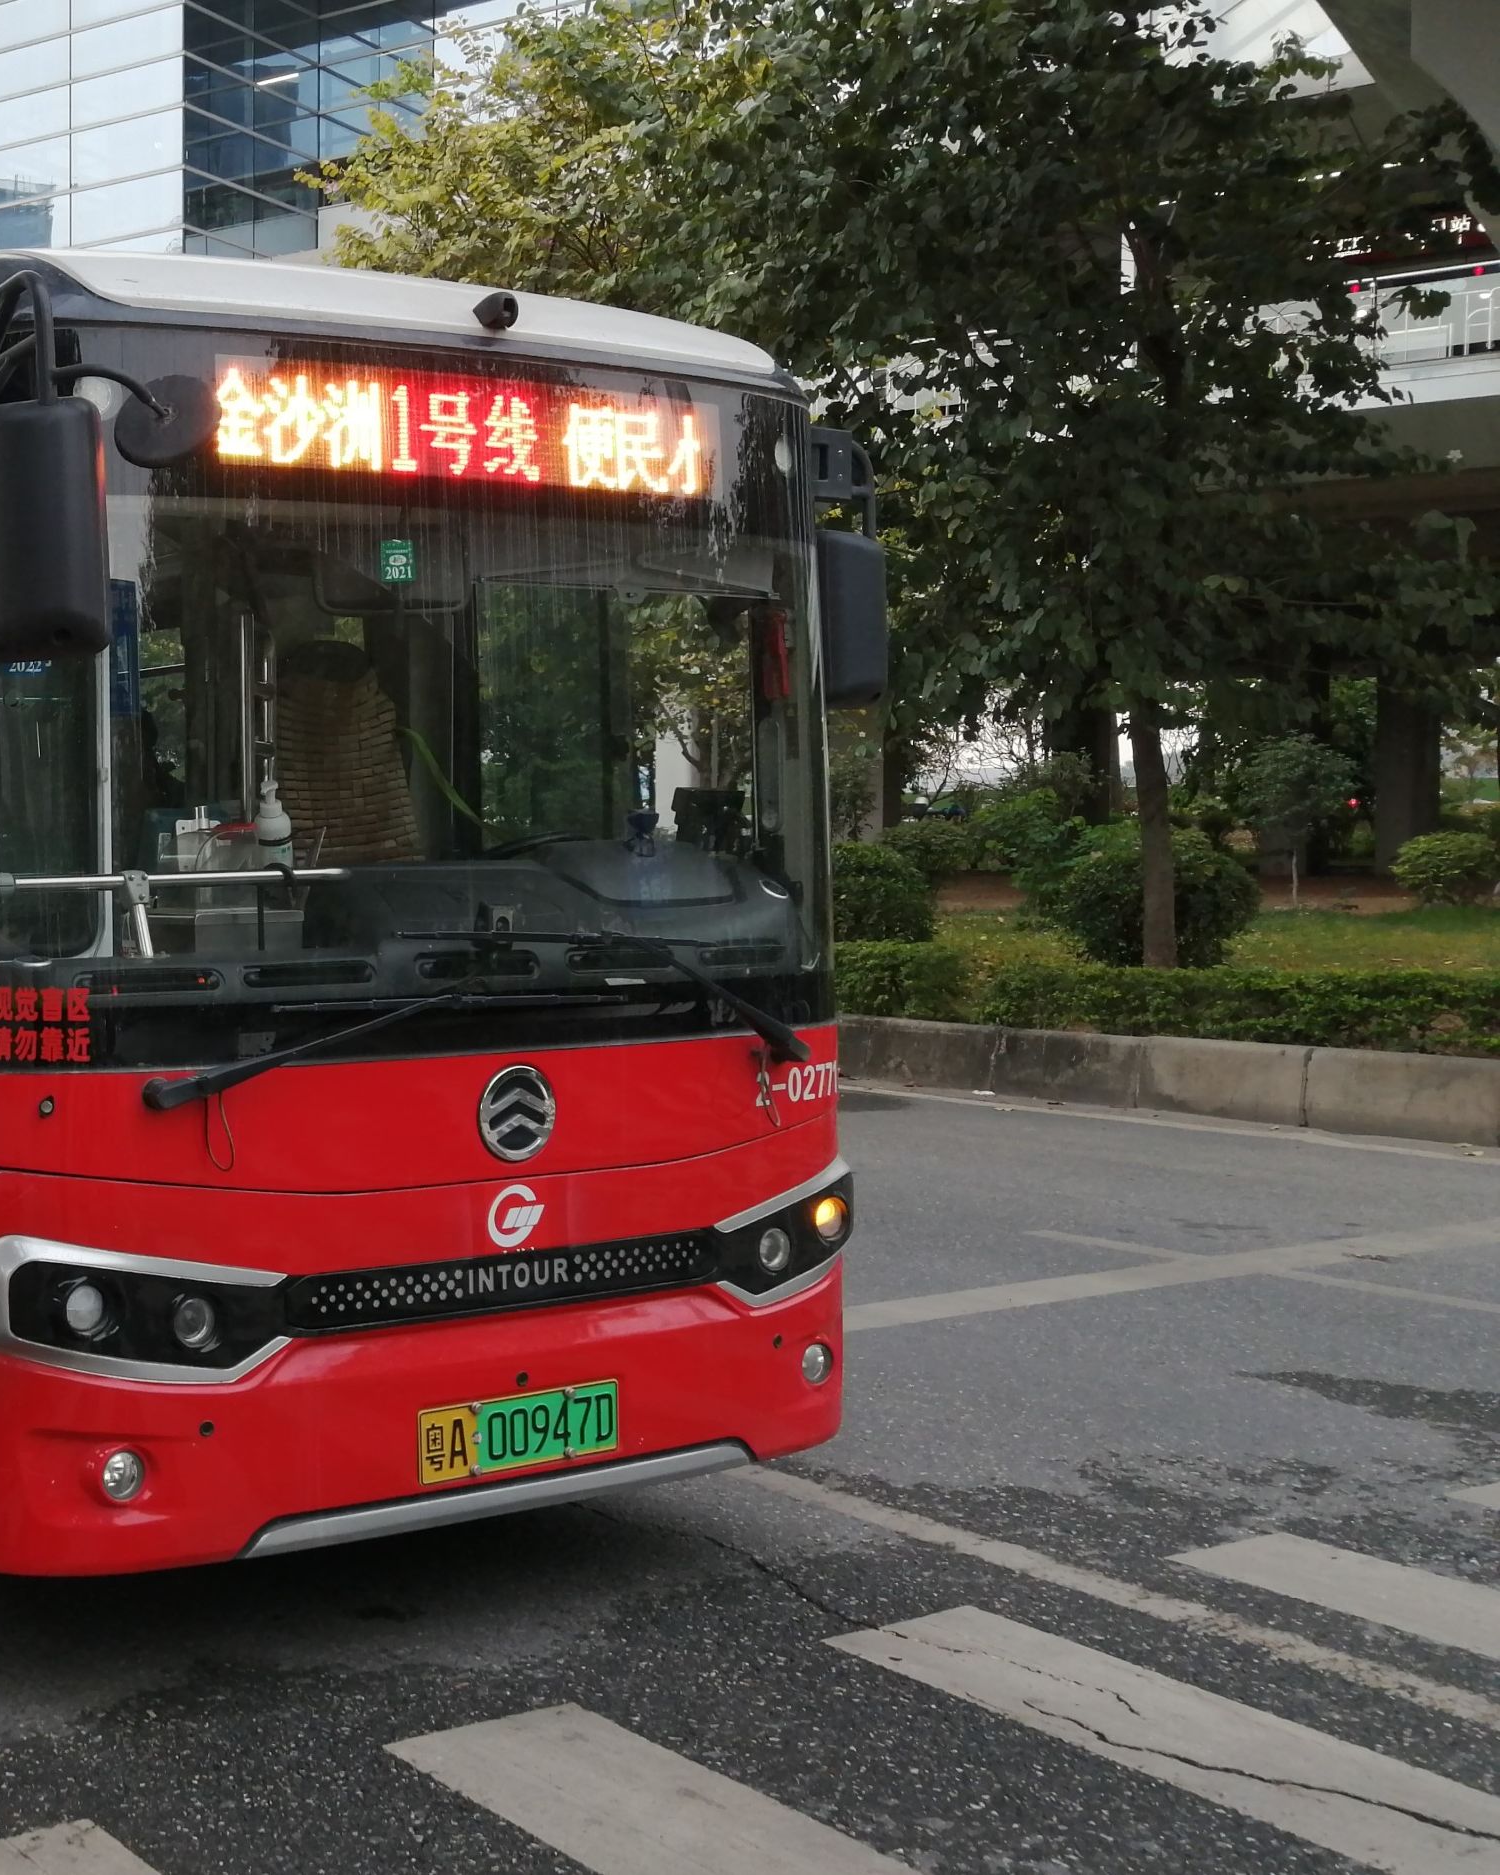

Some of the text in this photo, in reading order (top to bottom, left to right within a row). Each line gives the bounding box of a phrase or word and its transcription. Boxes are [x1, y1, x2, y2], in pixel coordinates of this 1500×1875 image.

[217, 368, 540, 482] 金沙洲1号线
[385, 566, 413, 580] 2021
[468, 1257, 569, 1295] INTOUR
[425, 1393, 614, 1472] 粤A 00947D
